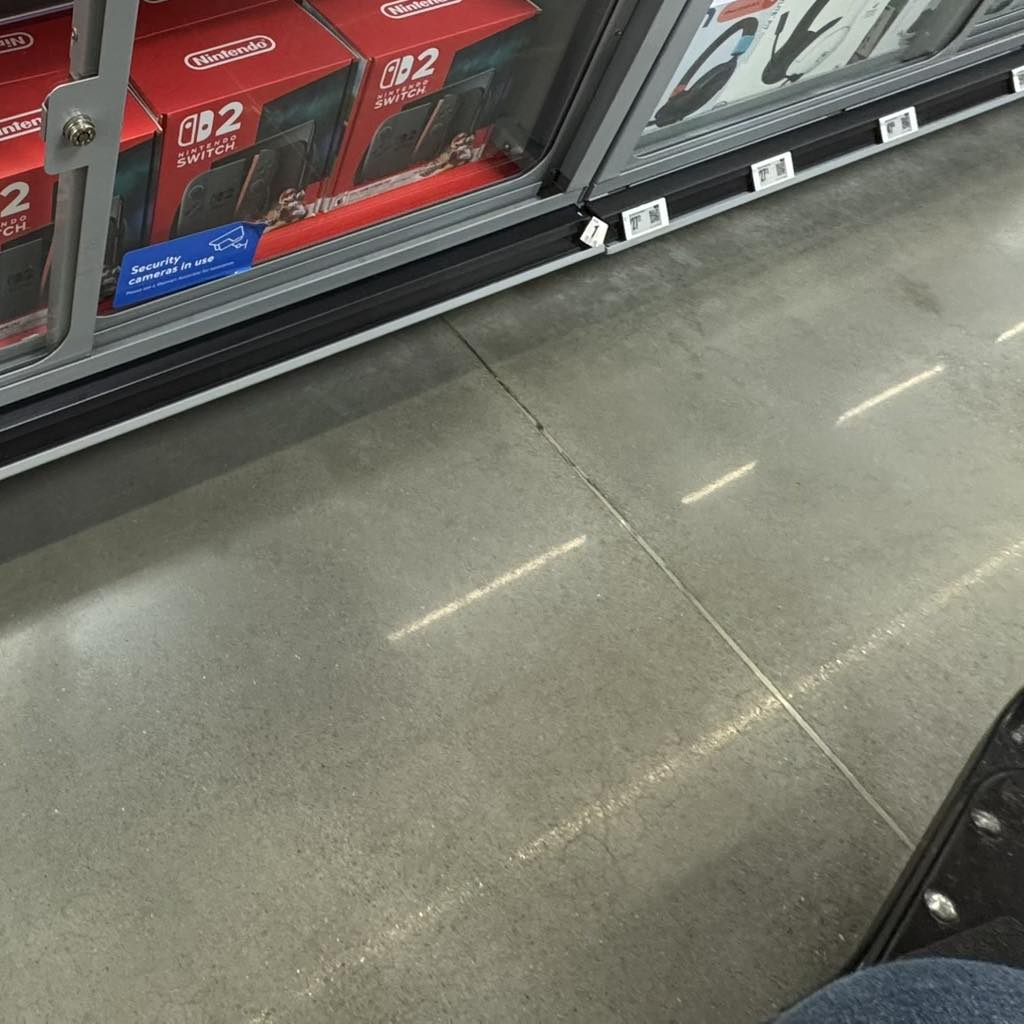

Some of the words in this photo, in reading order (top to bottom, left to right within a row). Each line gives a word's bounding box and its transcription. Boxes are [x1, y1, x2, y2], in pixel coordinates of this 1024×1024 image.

[417, 48, 439, 78] 2
[374, 87, 427, 109] SWITCH
[377, 80, 428, 100] NINTENDO
[216, 101, 243, 135] 2
[177, 142, 235, 168] SWITCH
[178, 135, 237, 159] NINTENDO
[0, 182, 30, 218] 2
[128, 267, 178, 286] cameras
[181, 261, 192, 271] in
[194, 255, 215, 266] use
[131, 255, 181, 275] Security
